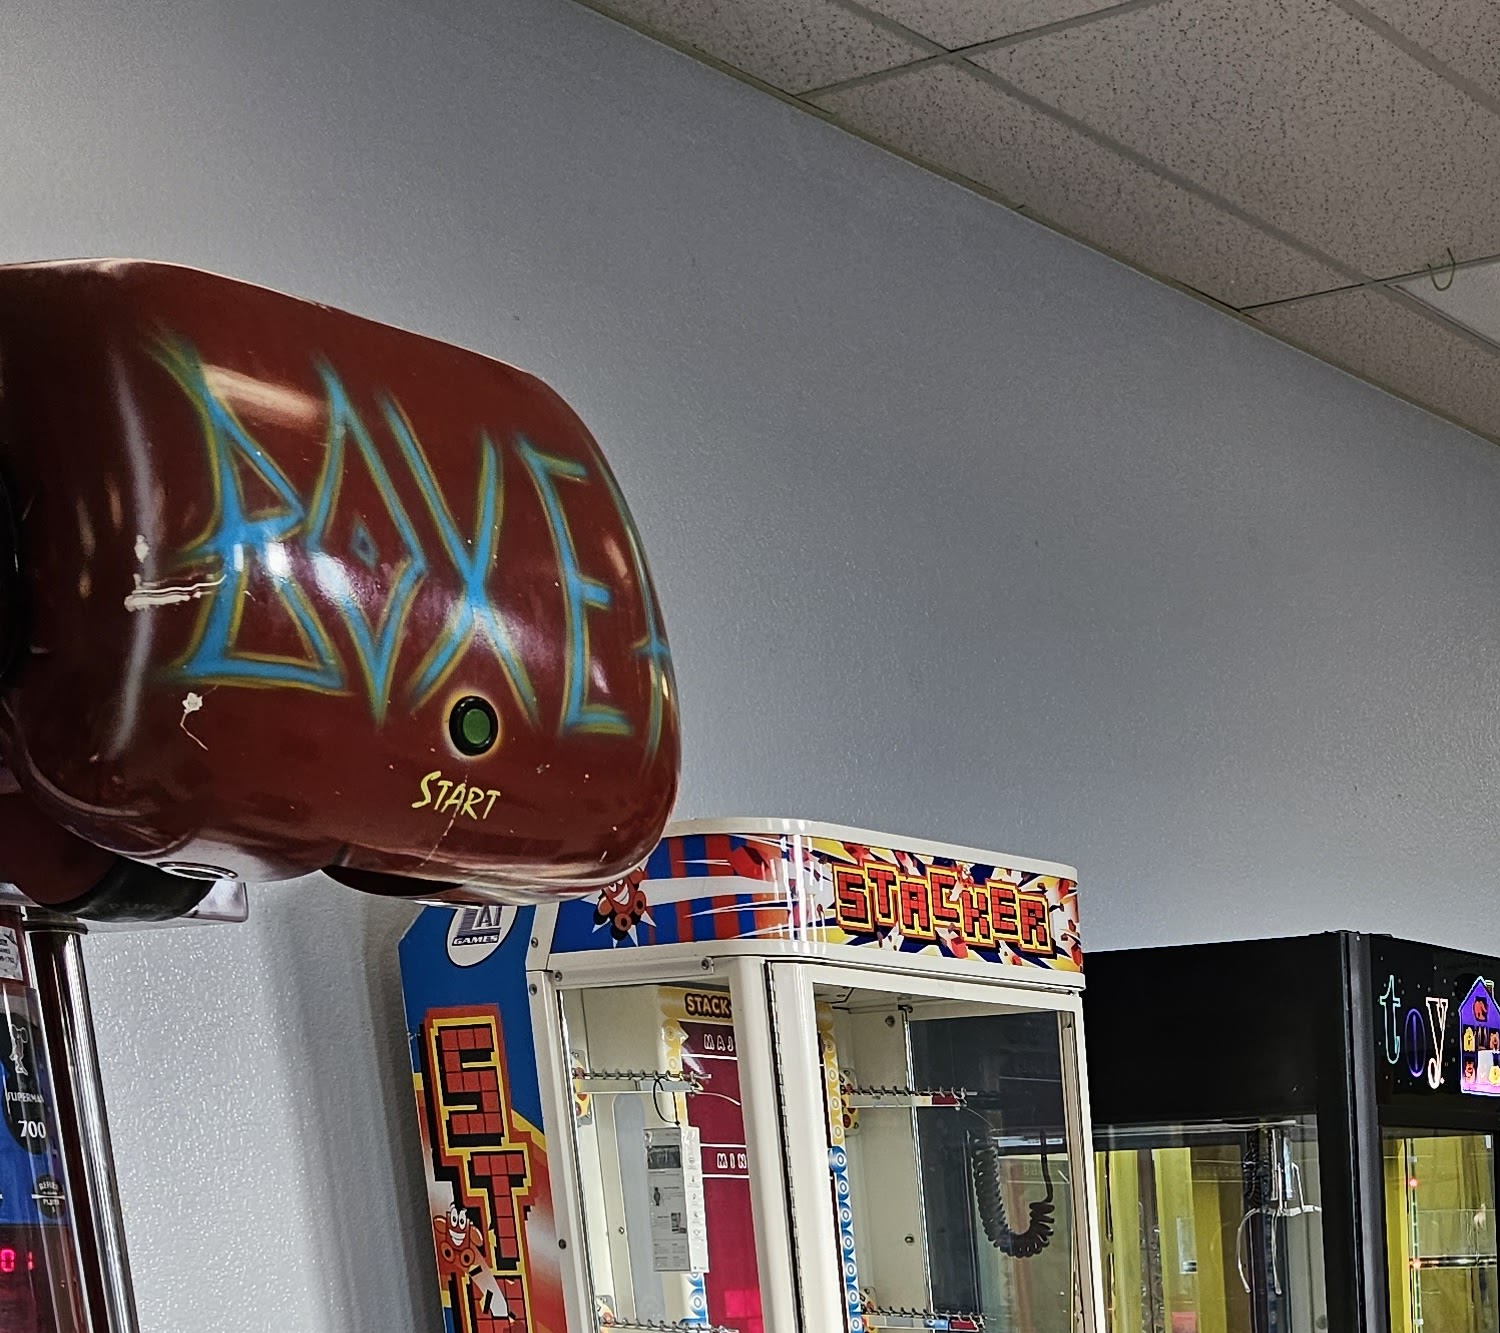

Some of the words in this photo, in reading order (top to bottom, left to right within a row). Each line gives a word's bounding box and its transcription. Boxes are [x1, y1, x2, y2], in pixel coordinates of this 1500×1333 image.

[411, 770, 501, 820] START
[833, 862, 1054, 955] STACKER
[452, 934, 500, 946] GAMES
[686, 993, 732, 1018] STACK
[704, 1033, 734, 1052] MAJ
[1380, 975, 1449, 1090] toy
[18, 1119, 46, 1139] 700
[716, 1152, 747, 1170] MIN
